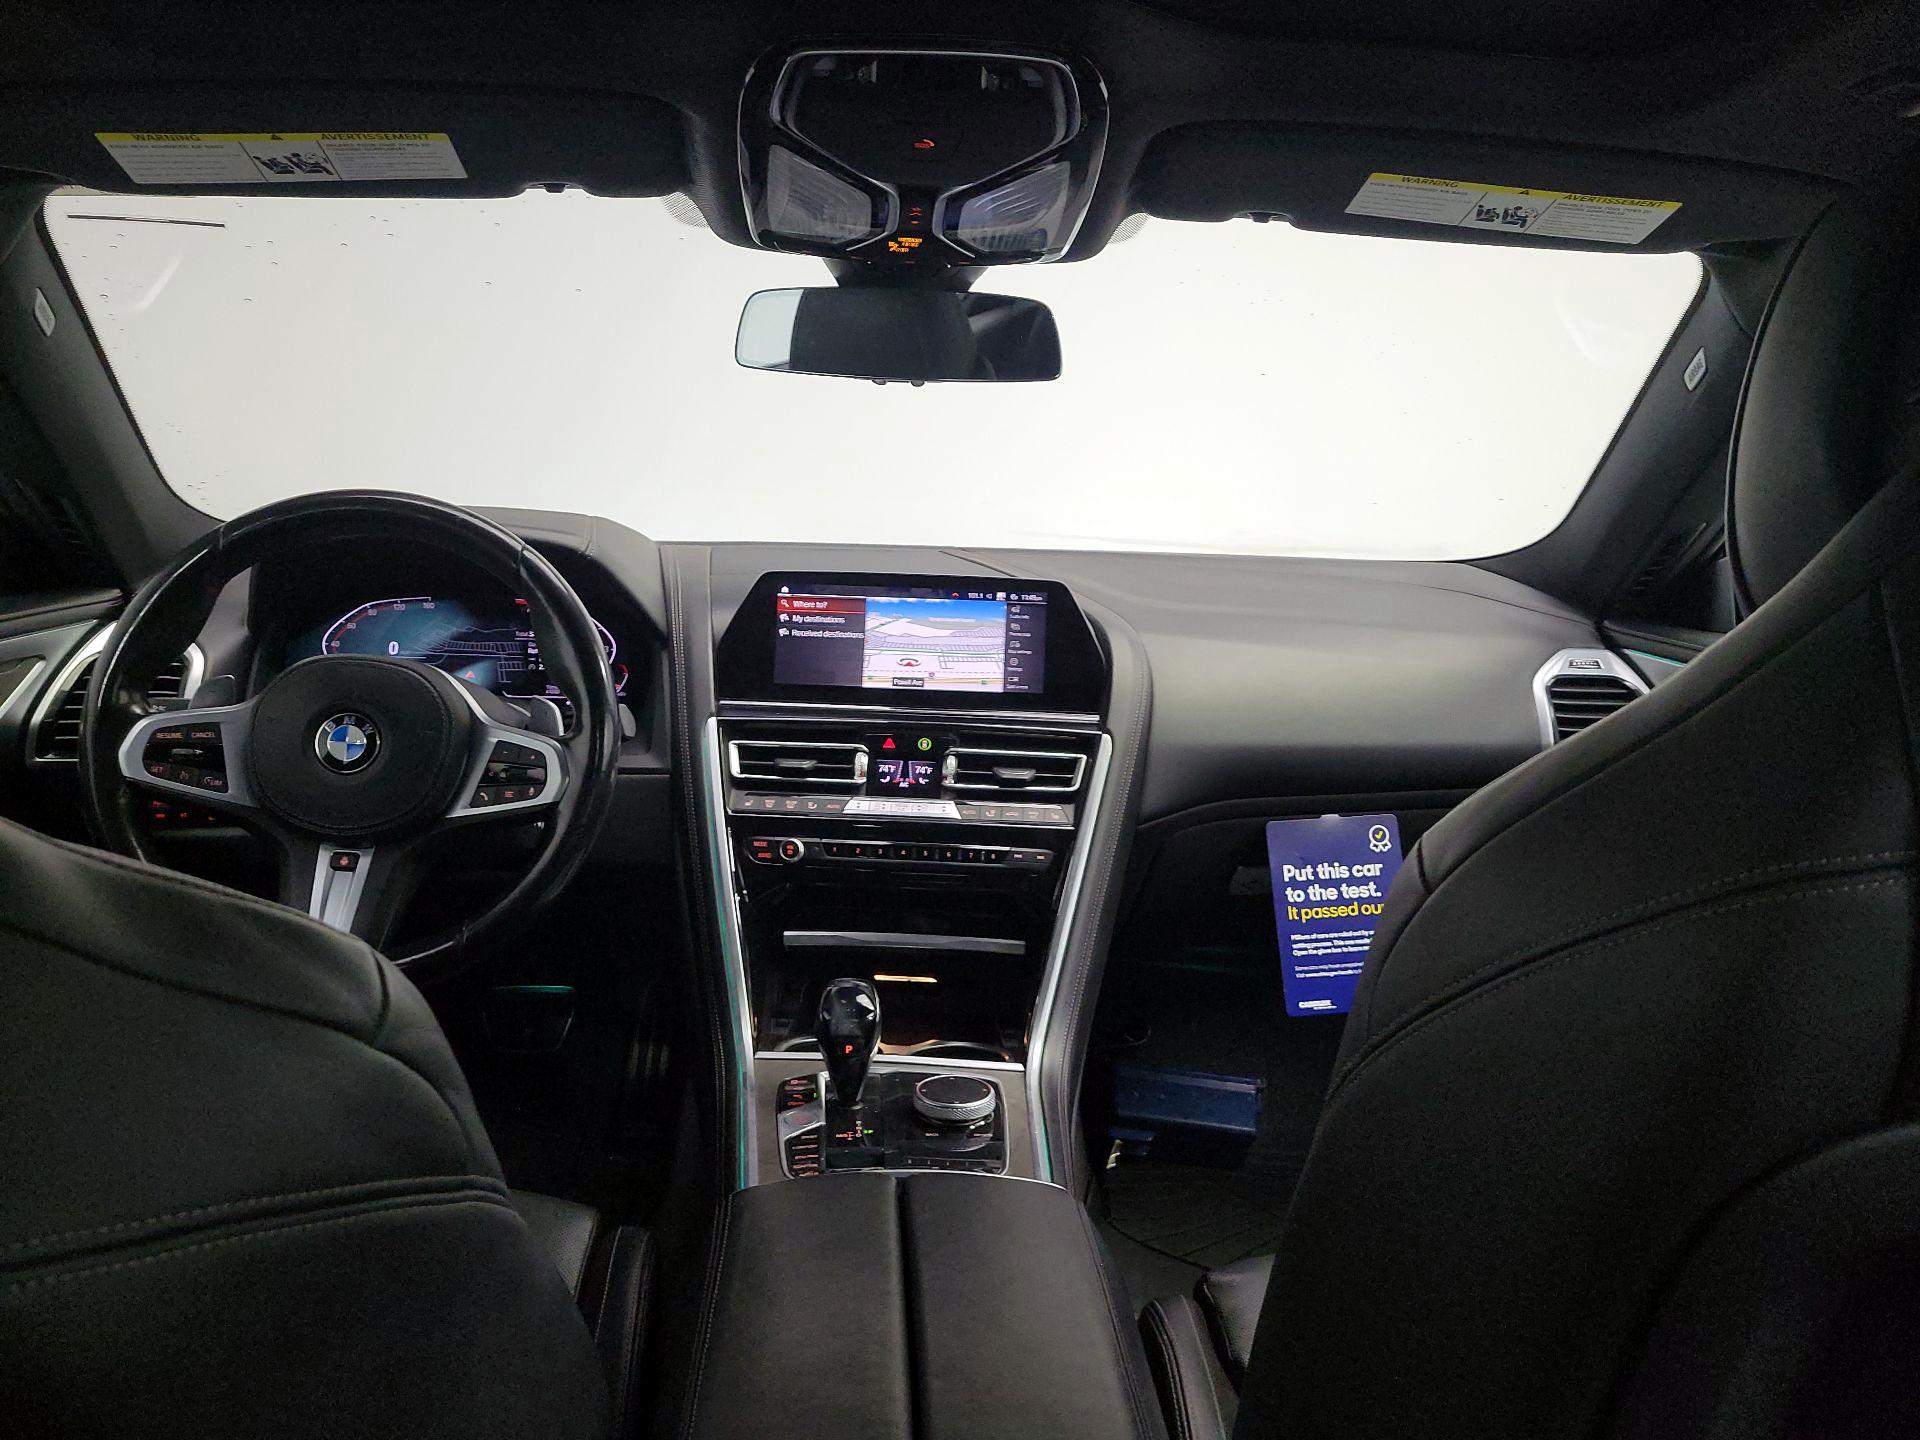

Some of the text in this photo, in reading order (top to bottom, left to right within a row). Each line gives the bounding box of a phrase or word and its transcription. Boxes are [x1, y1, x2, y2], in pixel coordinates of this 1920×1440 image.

[131, 133, 201, 141] WARNING
[321, 133, 429, 141] AVERTISSEMENT
[1401, 176, 1459, 188] WARNING
[1563, 194, 1665, 208] AVERTISSEMENT
[792, 600, 828, 609] Where to?
[792, 615, 845, 623] My destinations
[792, 629, 864, 638] Received destinations
[388, 641, 399, 656] 0
[1283, 862, 1383, 882] Put this car
[1285, 882, 1382, 903] to the test.
[1287, 902, 1384, 923] It passed ou
[845, 1045, 853, 1053] P
